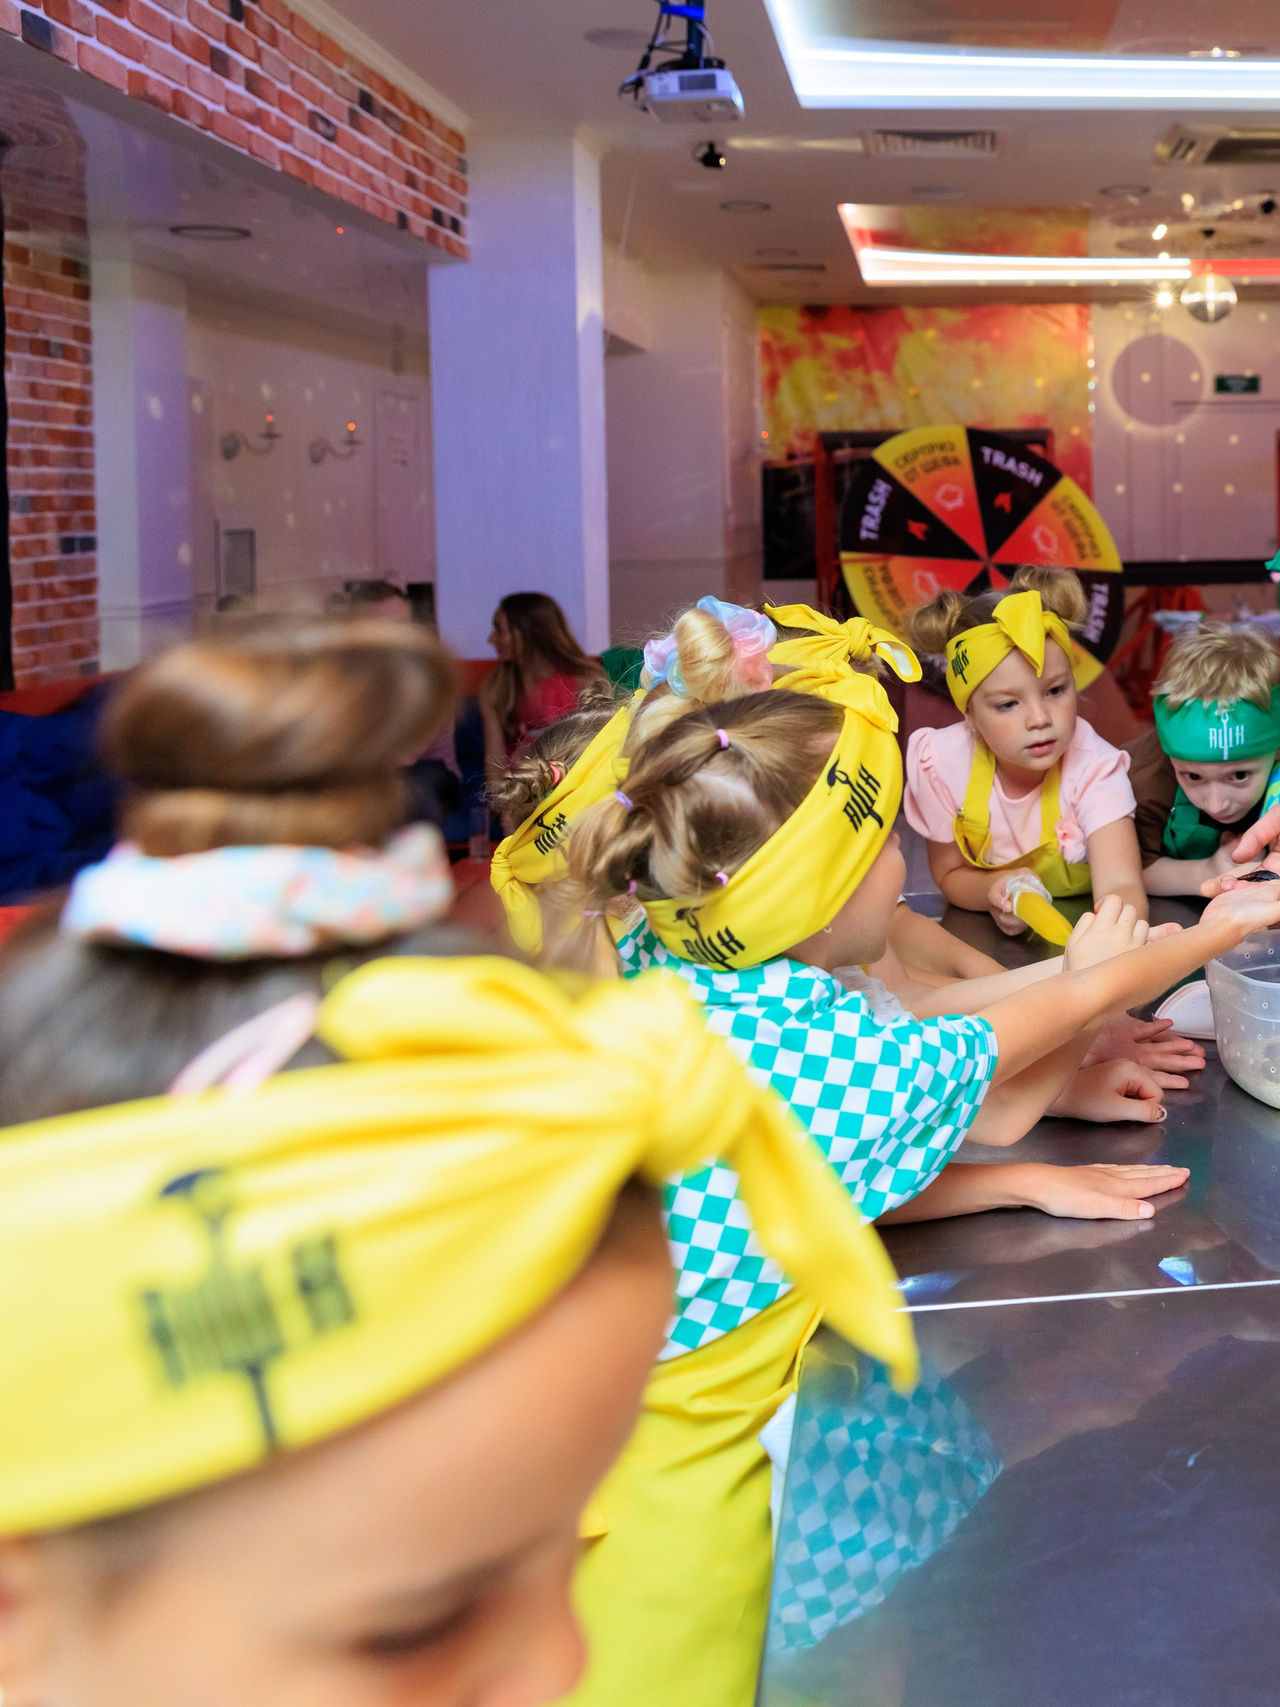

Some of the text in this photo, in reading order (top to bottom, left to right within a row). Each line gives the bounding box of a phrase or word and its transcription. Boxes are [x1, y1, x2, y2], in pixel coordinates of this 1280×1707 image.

[981, 445, 1044, 488] TRASH
[859, 478, 893, 541] TRASH
[1083, 583, 1110, 644] TRASH
